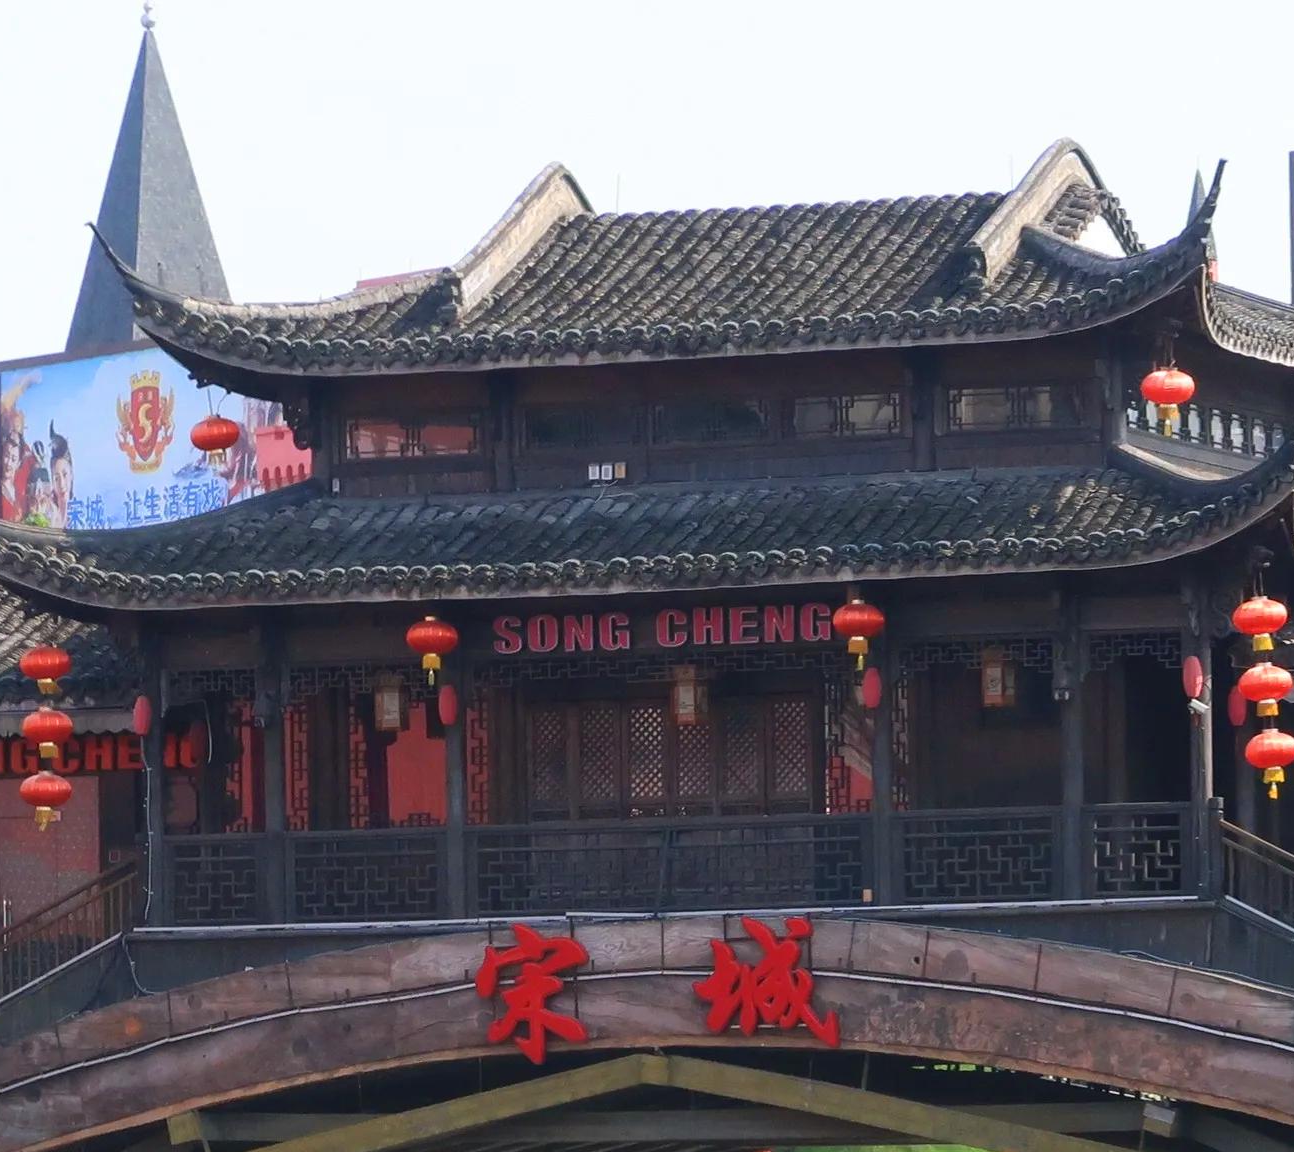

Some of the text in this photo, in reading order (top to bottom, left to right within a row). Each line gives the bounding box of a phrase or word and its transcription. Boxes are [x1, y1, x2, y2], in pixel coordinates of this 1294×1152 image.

[493, 602, 832, 654] SONG CHENG
[475, 916, 840, 1065] 宋城
